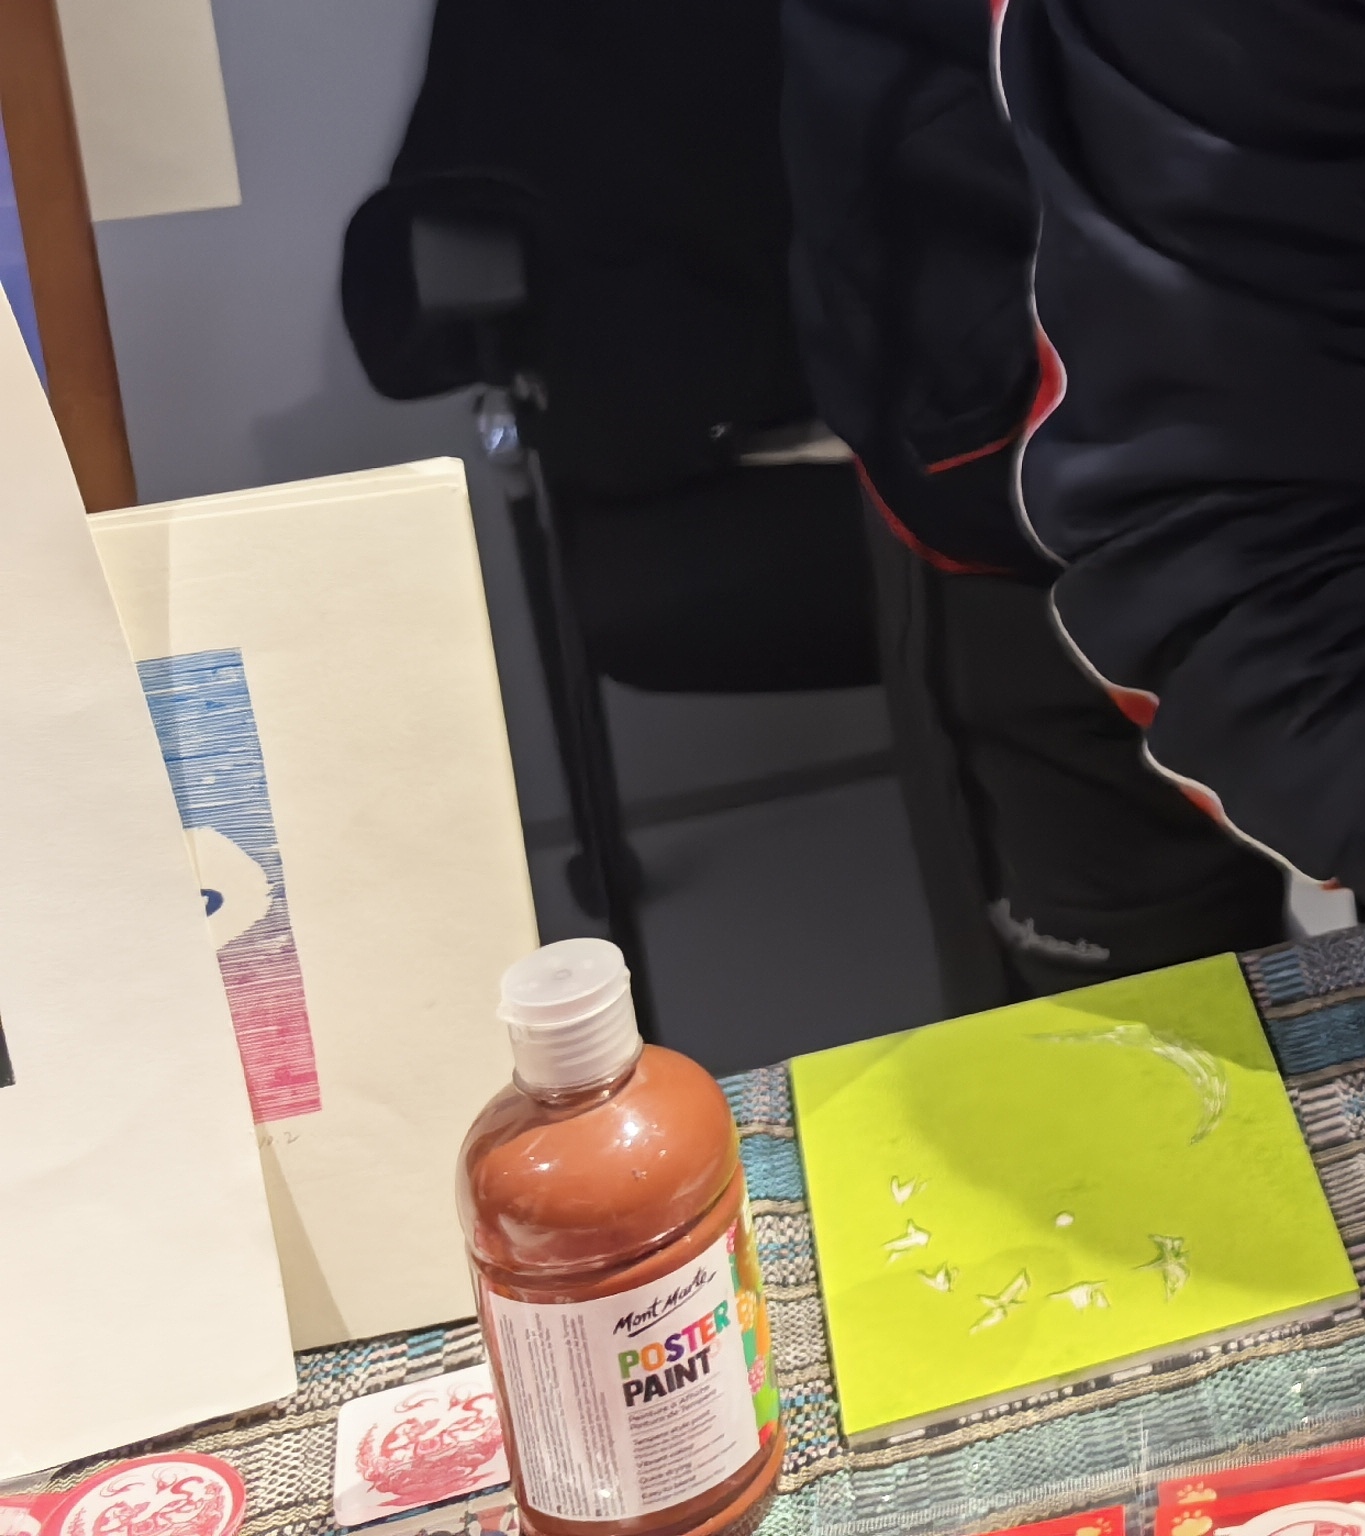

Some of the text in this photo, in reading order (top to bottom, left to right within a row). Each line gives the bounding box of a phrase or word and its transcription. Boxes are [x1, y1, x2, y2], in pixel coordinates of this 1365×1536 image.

[613, 1298, 662, 1335] Mont
[618, 1300, 731, 1378] POSTER
[622, 1348, 712, 1407] PAINT
